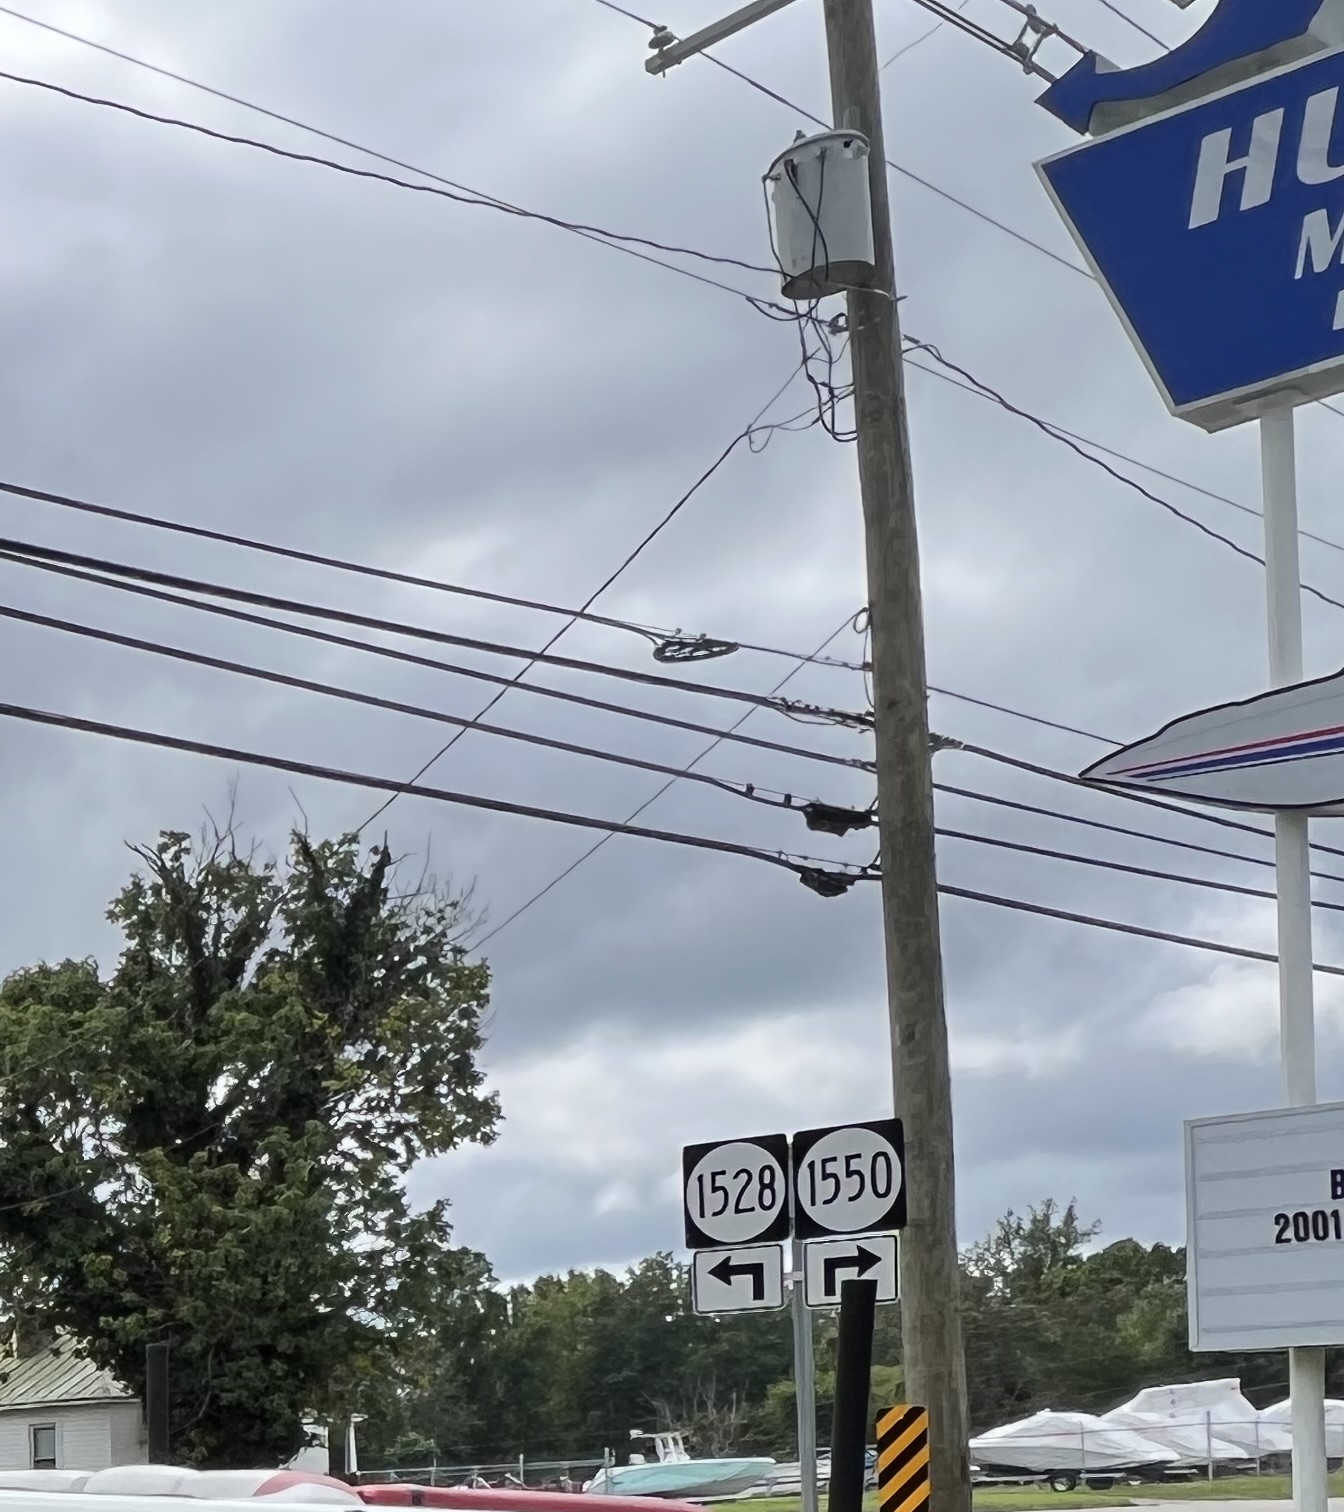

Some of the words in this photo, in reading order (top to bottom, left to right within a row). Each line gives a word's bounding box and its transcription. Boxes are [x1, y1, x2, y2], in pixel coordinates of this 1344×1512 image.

[697, 1164, 776, 1219] 1528
[807, 1151, 892, 1207] 1550
[1274, 1209, 1342, 1244] 2001
